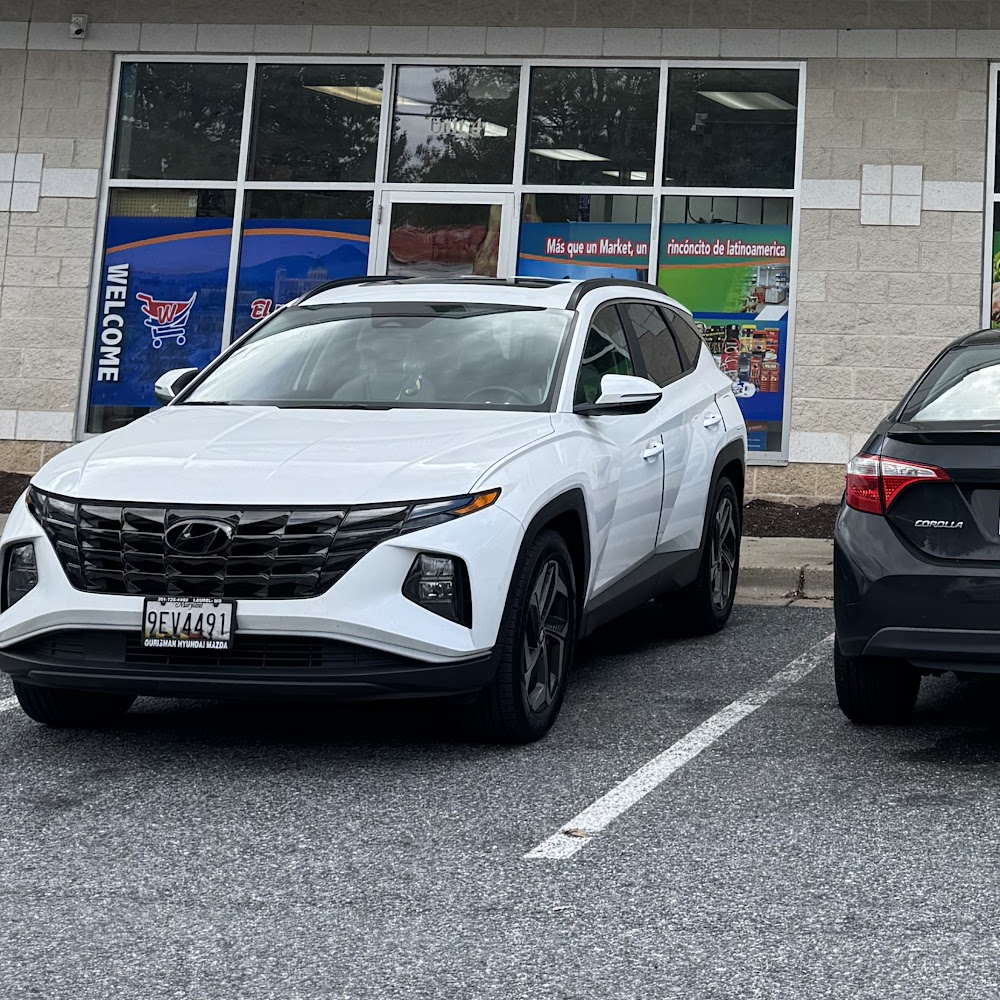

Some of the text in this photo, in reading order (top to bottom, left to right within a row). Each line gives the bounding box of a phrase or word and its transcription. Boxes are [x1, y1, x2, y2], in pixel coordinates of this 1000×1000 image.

[470, 117, 483, 134] 4
[546, 238, 648, 257] Más que un Market, un
[667, 239, 786, 257] rincóncito de latinoamerica
[251, 299, 272, 319] El
[97, 263, 130, 382] WELCOME
[914, 519, 964, 529] COROLLA
[147, 611, 226, 636] 9EV4491
[177, 640, 206, 649] HYUNDAI
[206, 641, 229, 650] MAZDA
